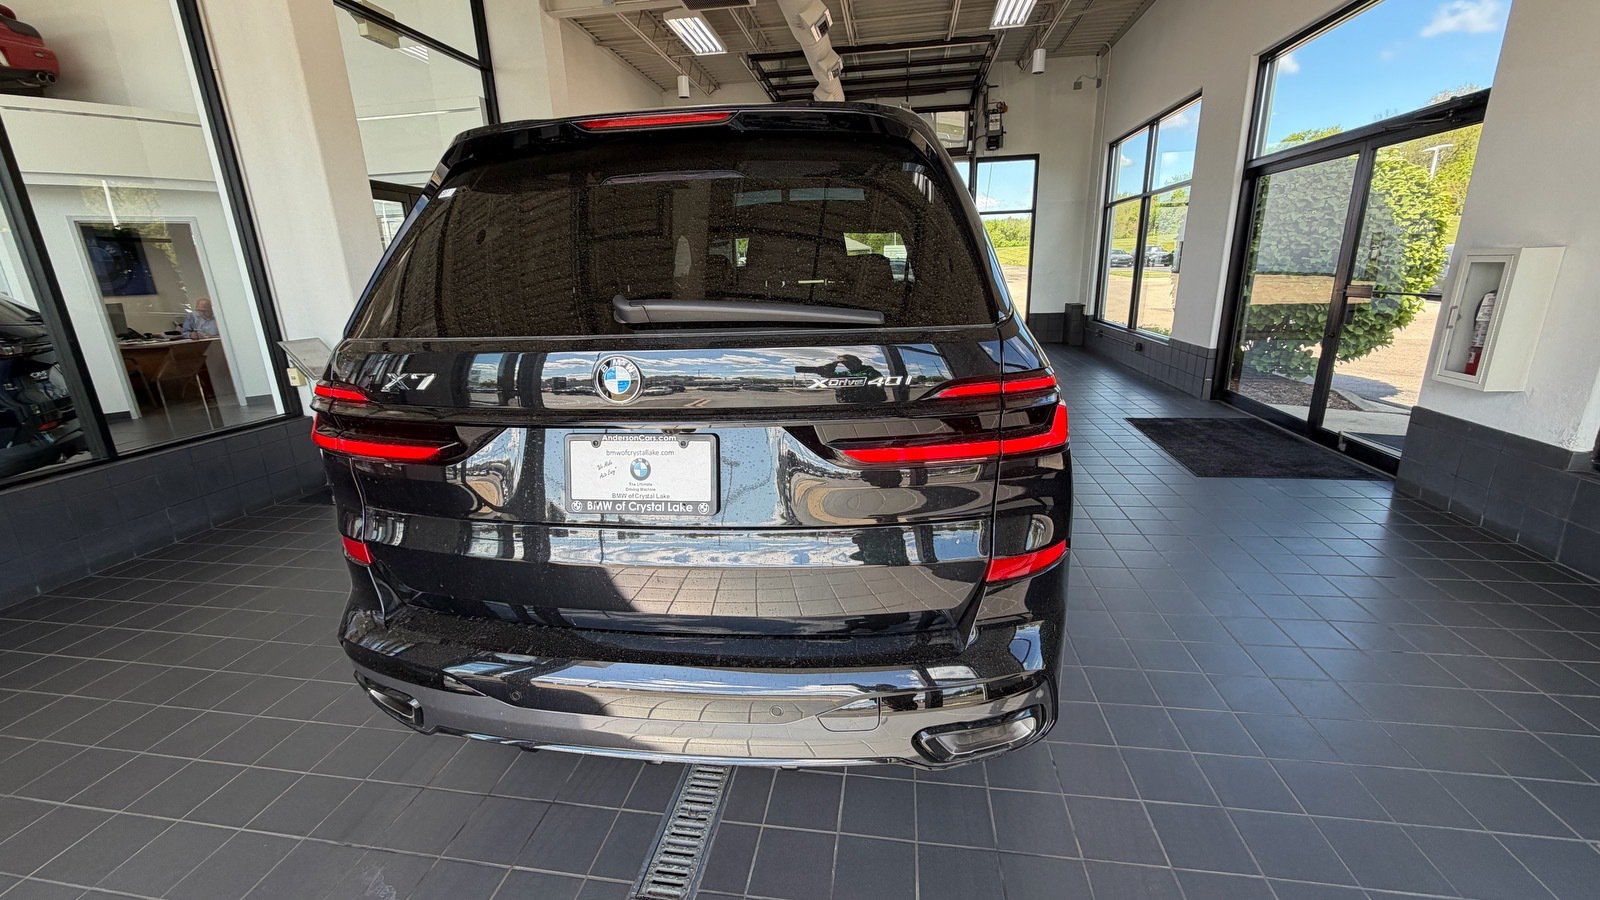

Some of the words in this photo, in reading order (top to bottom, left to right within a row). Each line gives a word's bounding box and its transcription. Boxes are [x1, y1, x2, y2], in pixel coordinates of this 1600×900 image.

[600, 359, 636, 373] BMW
[381, 372, 436, 391] X7
[606, 449, 675, 457] bmwofcrystallake.com
[587, 500, 613, 511] BMW
[615, 501, 626, 511] of
[628, 501, 665, 514] Crystal
[667, 502, 694, 512] Lake
